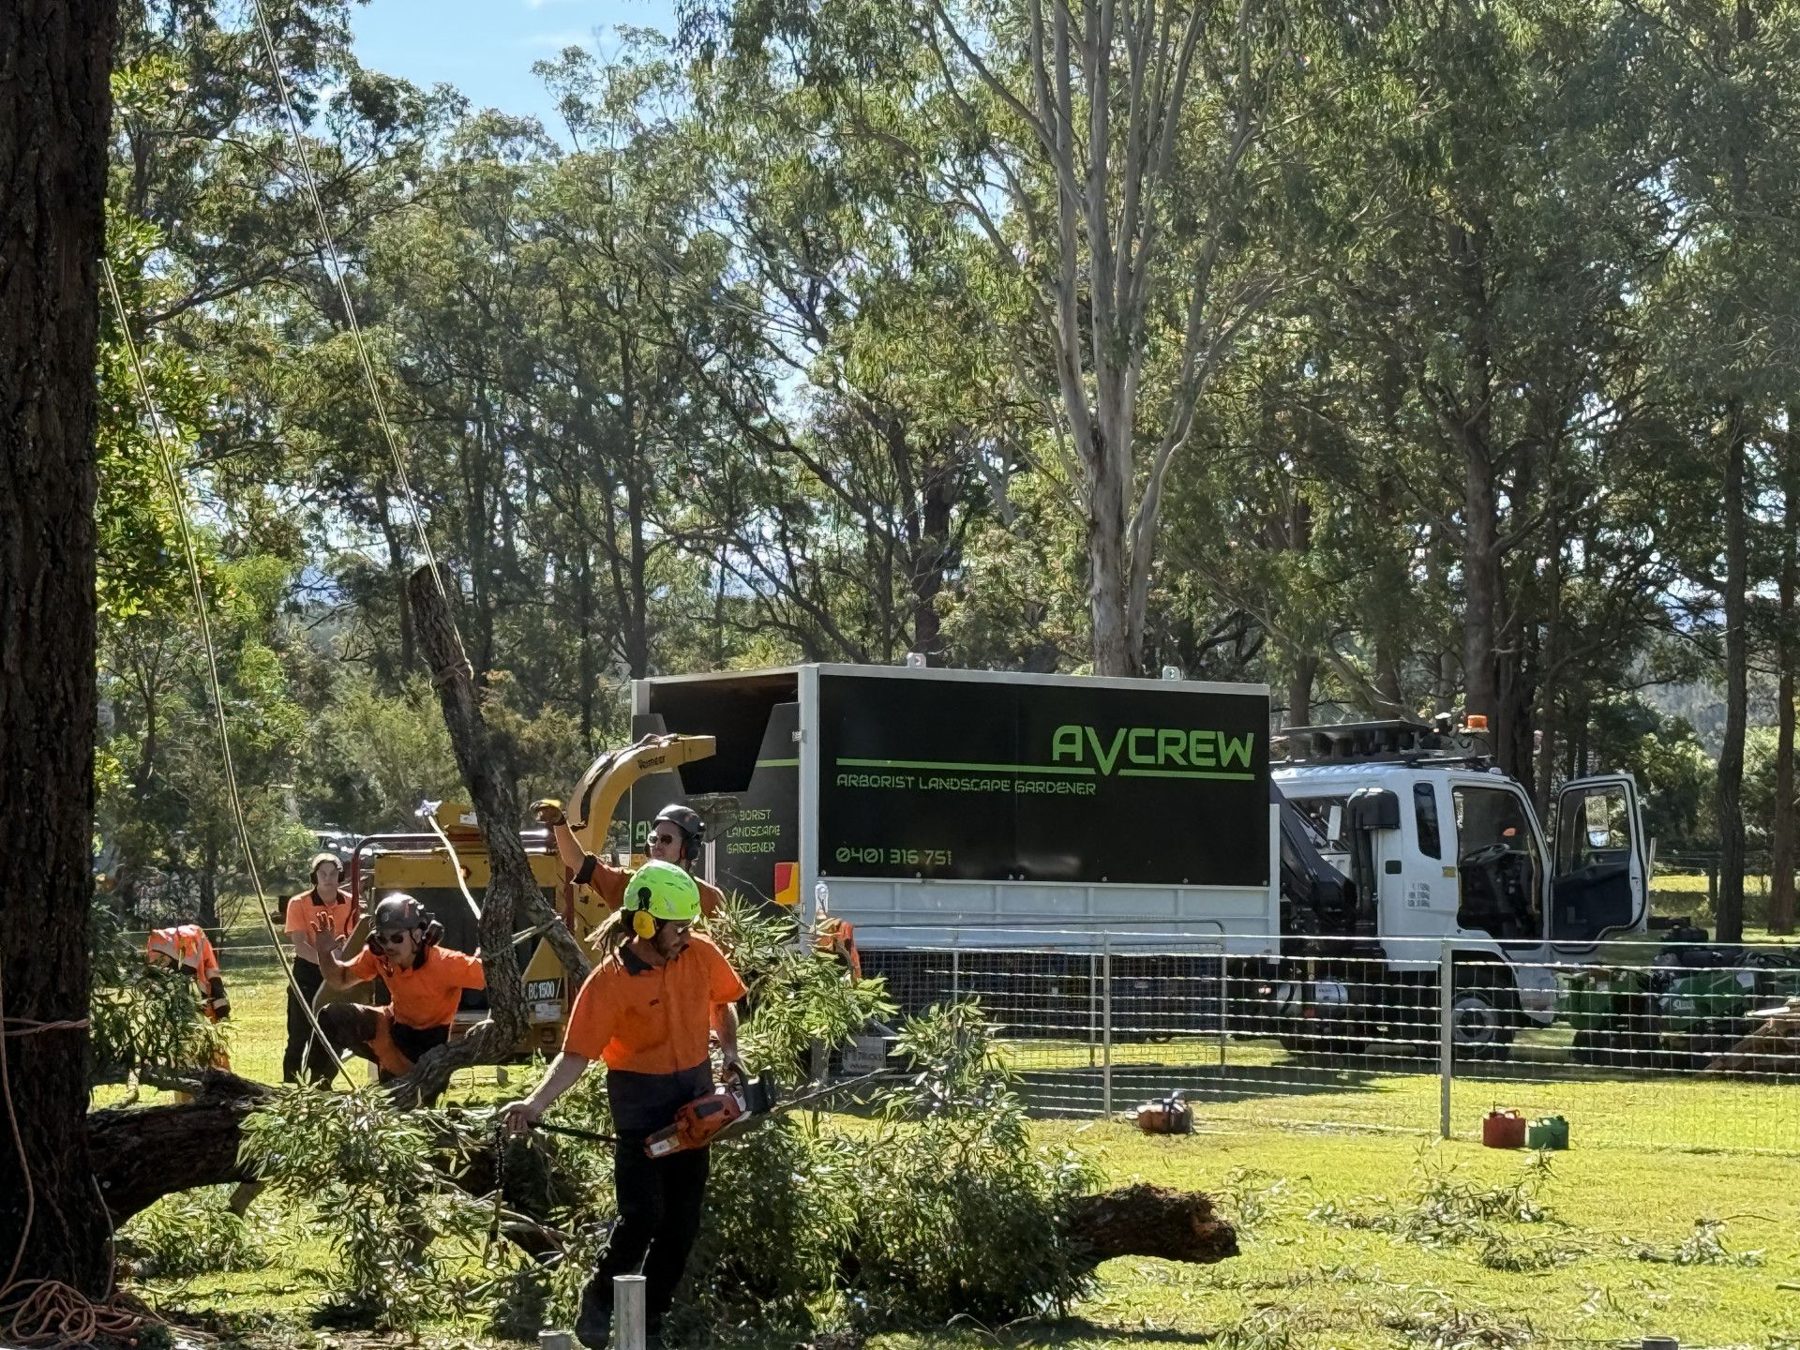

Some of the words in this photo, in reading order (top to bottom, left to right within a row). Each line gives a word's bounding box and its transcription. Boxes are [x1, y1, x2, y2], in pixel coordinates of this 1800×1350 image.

[1053, 725, 1254, 776] AVCREW
[837, 773, 914, 789] ARBORIST
[917, 776, 1010, 791] LANDSCAPE
[1014, 780, 1096, 796] GARDENER
[836, 847, 884, 864] 0401
[890, 848, 919, 865] 316
[924, 849, 953, 866] 751
[528, 982, 539, 1000] BC
[539, 980, 555, 998] 1500
